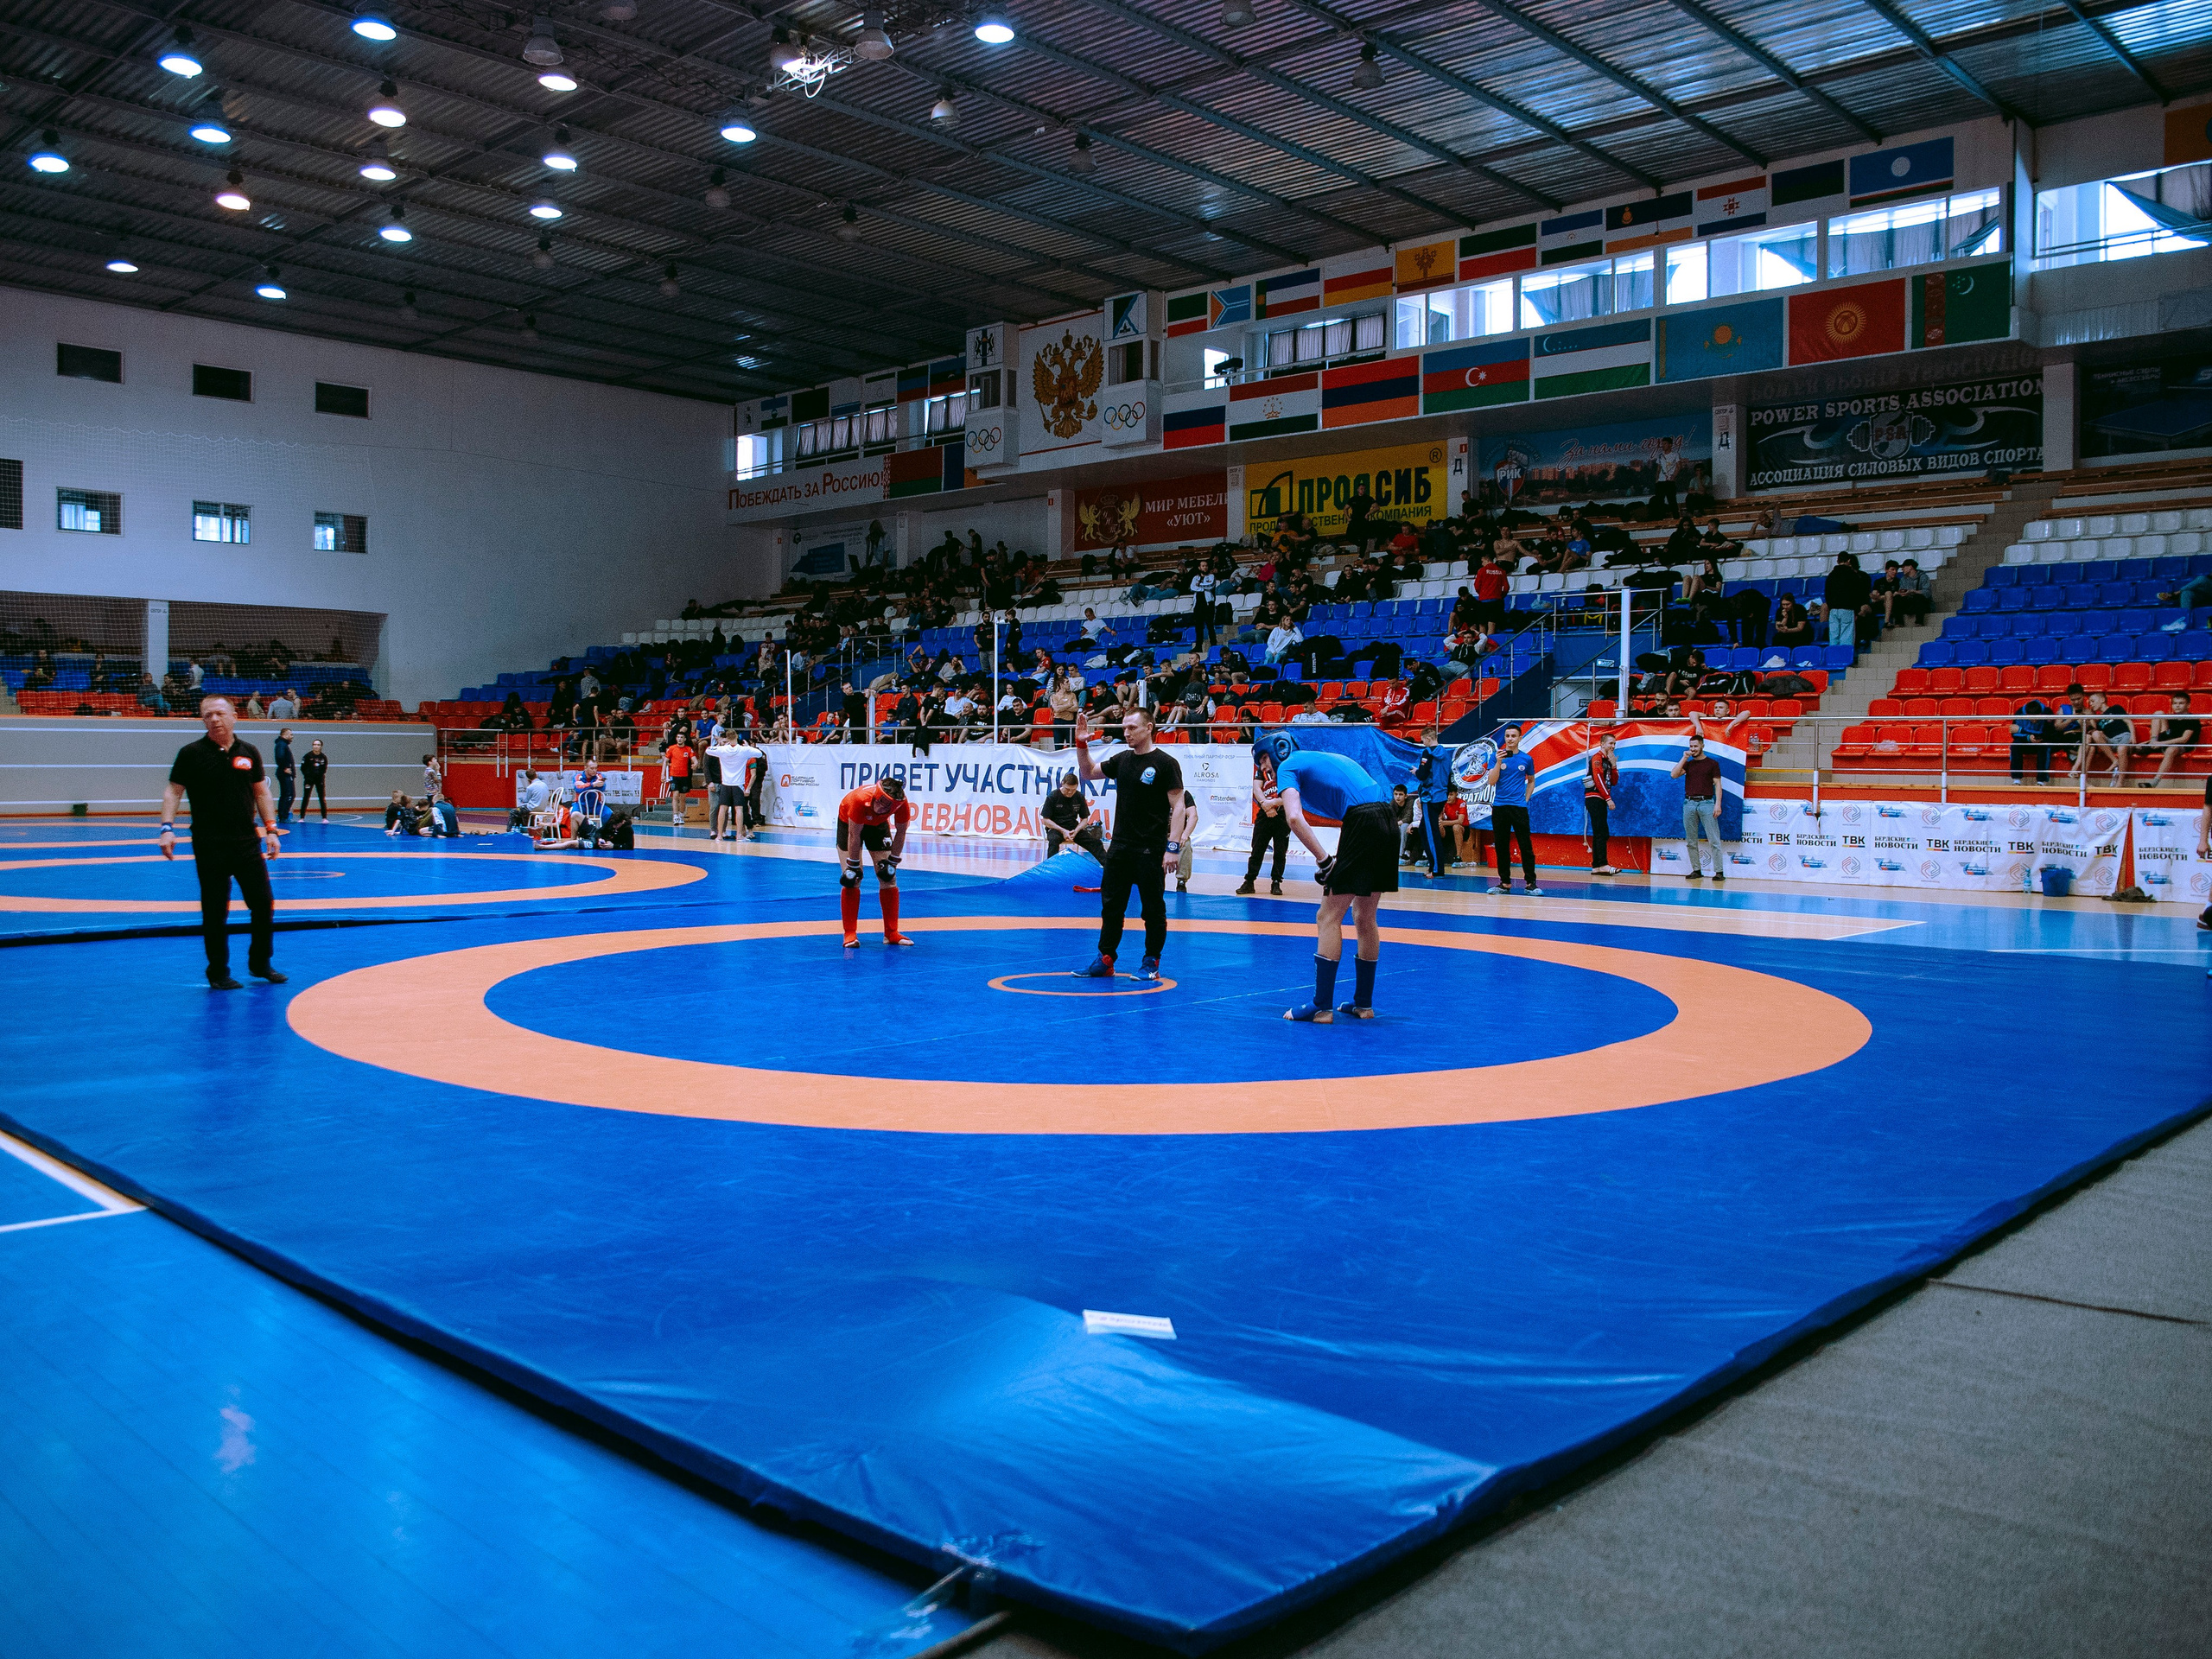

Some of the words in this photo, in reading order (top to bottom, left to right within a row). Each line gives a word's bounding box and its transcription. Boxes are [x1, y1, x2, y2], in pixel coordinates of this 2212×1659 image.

[1750, 404, 1819, 426] POWER
[1825, 394, 1902, 418] SPORTS
[1718, 431, 1730, 450] Д
[1452, 458, 1463, 475] Д
[1749, 461, 1844, 486] АССОЦИАЦИЯ
[1847, 457, 1923, 477] СИЛОВЫХ
[1927, 451, 1980, 472] ВИДОВ
[1498, 467, 1522, 481] РИК
[728, 485, 802, 510] ПОБЕЖДАТЬ
[804, 481, 820, 498] ЗА
[1145, 499, 1173, 513] МИР
[1166, 512, 1211, 527] «УЮТ»
[841, 763, 939, 791] ПРИВЕТ
[944, 763, 1117, 796] УЧАСТНИКА
[1769, 833, 1790, 842] ТВК
[1842, 836, 1866, 844] ТВК
[1927, 838, 1949, 848] ТВК
[2008, 842, 2034, 850] ТВК
[2042, 847, 2087, 857] НОВОСТИ
[2094, 845, 2118, 855] ТВК
